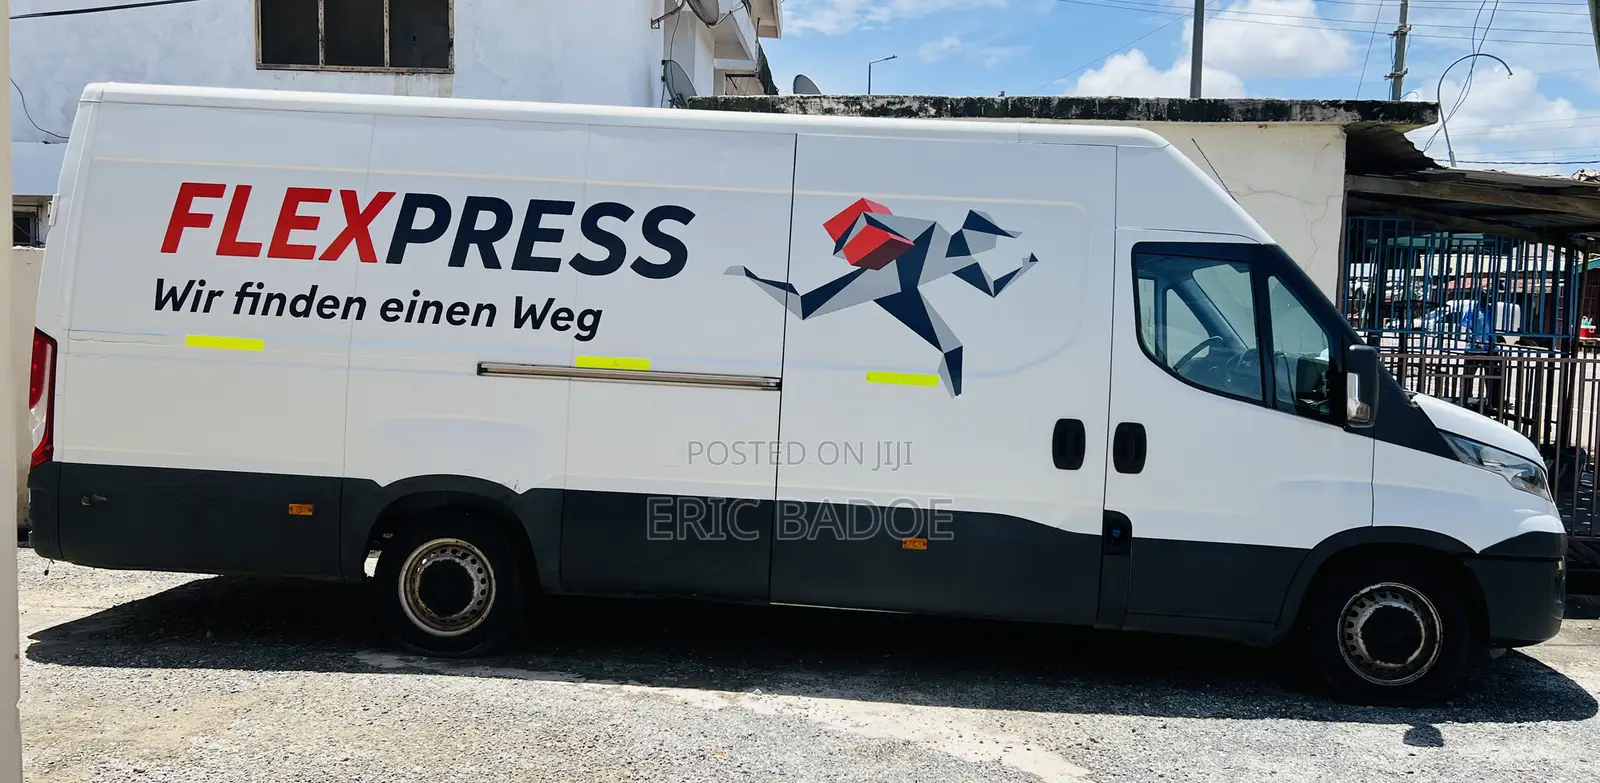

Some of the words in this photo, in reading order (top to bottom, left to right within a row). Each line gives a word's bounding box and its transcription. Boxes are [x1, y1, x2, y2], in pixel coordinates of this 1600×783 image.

[160, 181, 696, 280] FLEXPRESS
[153, 278, 224, 315] Wir
[233, 282, 367, 322] finden
[379, 289, 497, 329] einen
[512, 296, 603, 342] Weg
